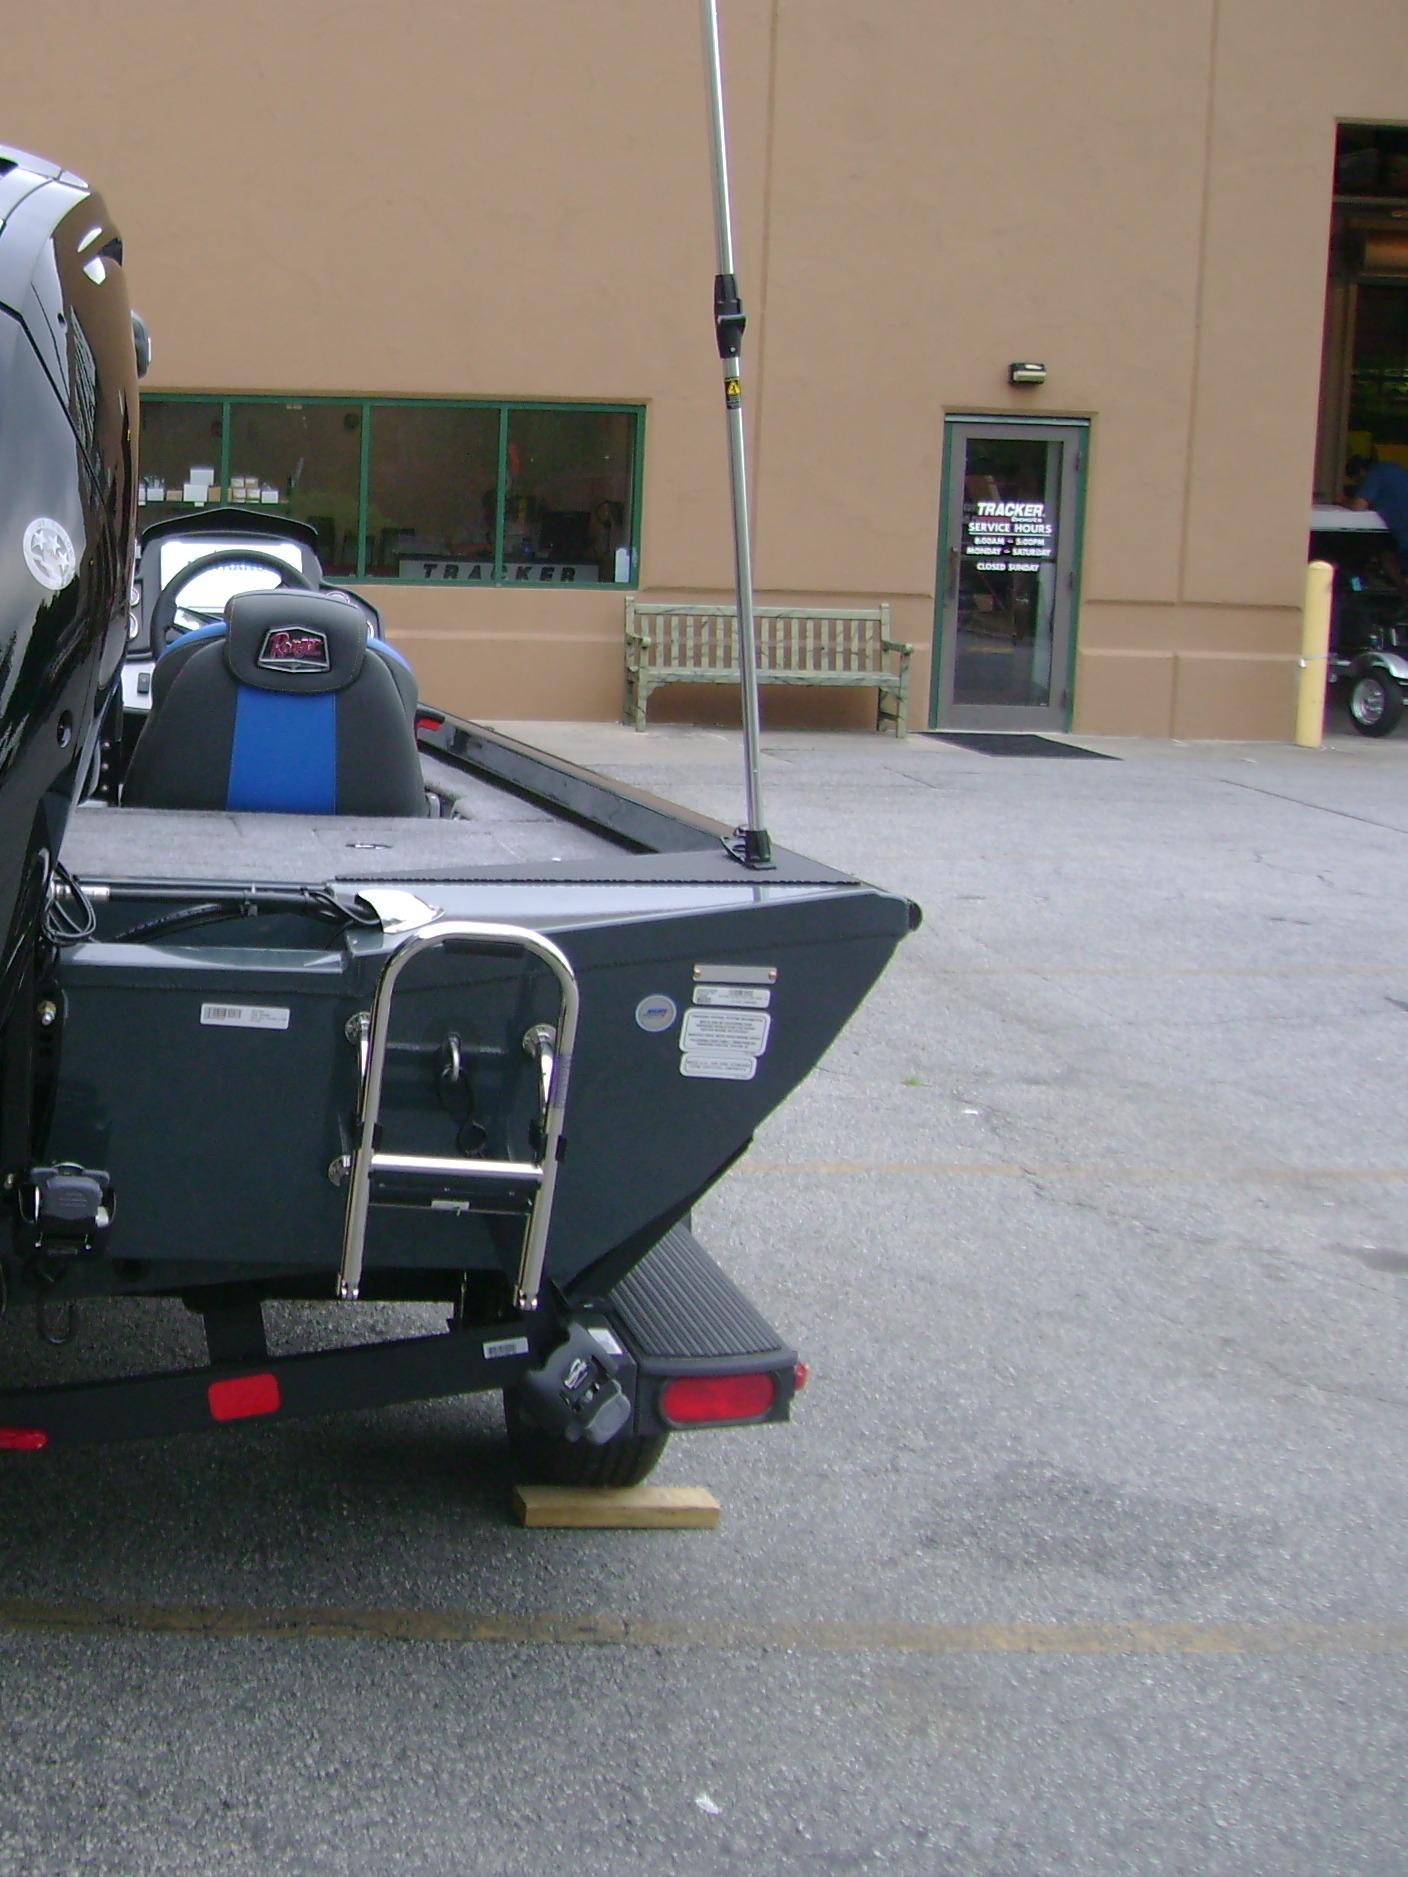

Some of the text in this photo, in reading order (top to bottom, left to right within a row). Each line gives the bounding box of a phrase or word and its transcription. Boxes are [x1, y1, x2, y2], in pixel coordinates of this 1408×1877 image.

[977, 502, 1044, 516] TRACKER
[968, 522, 1052, 534] SERVICE HOURS
[966, 546, 1002, 555] MONDAY
[1012, 548, 1052, 556] SATURDAY
[423, 563, 576, 582] TRACKER
[976, 562, 1040, 572] CLOSED SUNDAY
